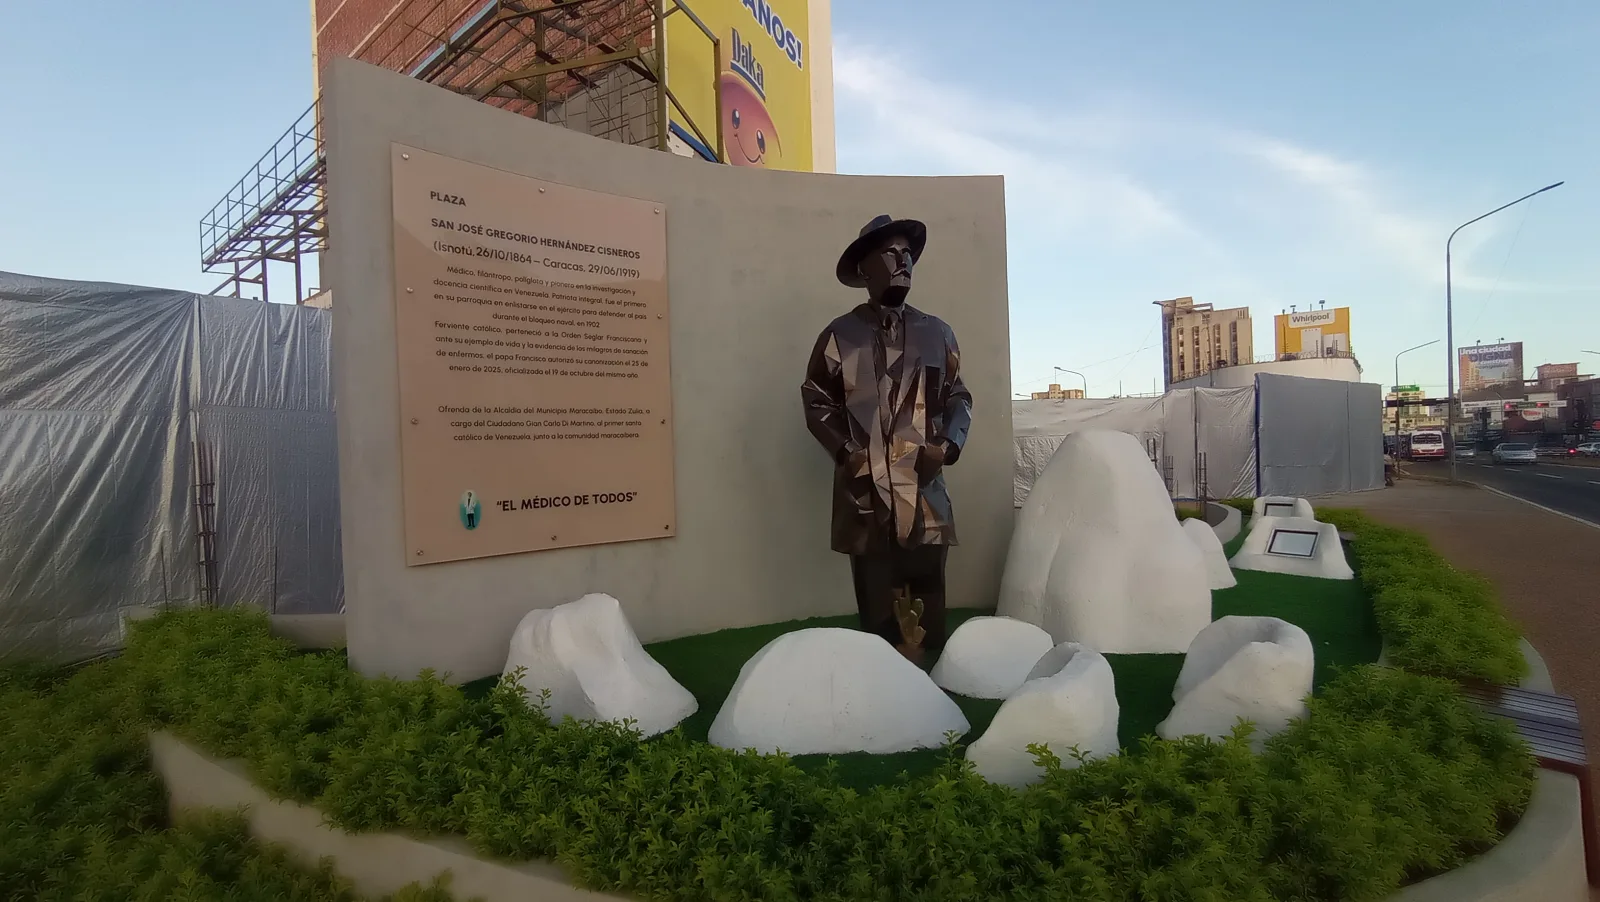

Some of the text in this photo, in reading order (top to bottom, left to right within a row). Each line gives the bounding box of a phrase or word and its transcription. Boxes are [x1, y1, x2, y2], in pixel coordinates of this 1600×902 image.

[731, 26, 765, 91] Daka
[430, 191, 467, 207] PLAZA
[431, 218, 641, 259] SAN JOSÉ GREGORIO HERNÁNDEZ CISNEROS
[476, 246, 532, 264] 26/10/1864
[543, 258, 585, 272] Caracas,
[588, 264, 641, 278] 29/06/1919)
[514, 275, 543, 285] políglota
[550, 281, 574, 289] pionero
[592, 285, 631, 295] investigación
[433, 278, 468, 289] docencia
[469, 283, 502, 293] científica
[551, 292, 577, 301] Patriota
[623, 301, 647, 309] primero
[456, 295, 492, 306] parroquia
[504, 301, 537, 310] enlistarse
[598, 309, 625, 318] defender
[492, 312, 519, 321] durante
[528, 315, 555, 325] bloqueo
[1292, 313, 1330, 323] Whirlpool
[434, 320, 470, 331] Ferviente
[505, 328, 541, 336] perteneció
[561, 331, 581, 339] Orden
[584, 333, 603, 341] Seglar
[464, 338, 493, 347] ejemplo
[494, 339, 504, 347] de
[505, 340, 520, 348] vida
[534, 343, 565, 351] evidencia
[586, 346, 612, 354] milagros
[1478, 344, 1511, 354] ciudad
[435, 349, 446, 357] de
[515, 353, 546, 362] Francisco
[548, 356, 574, 364] autorizó
[504, 366, 543, 375] oficializada
[569, 370, 594, 378] octubre
[438, 405, 470, 413] Ofrenda
[453, 433, 482, 441] católico
[484, 433, 493, 441] de
[533, 433, 550, 441] junto
[520, 495, 571, 510] MÉDICO
[574, 495, 589, 506] DE
